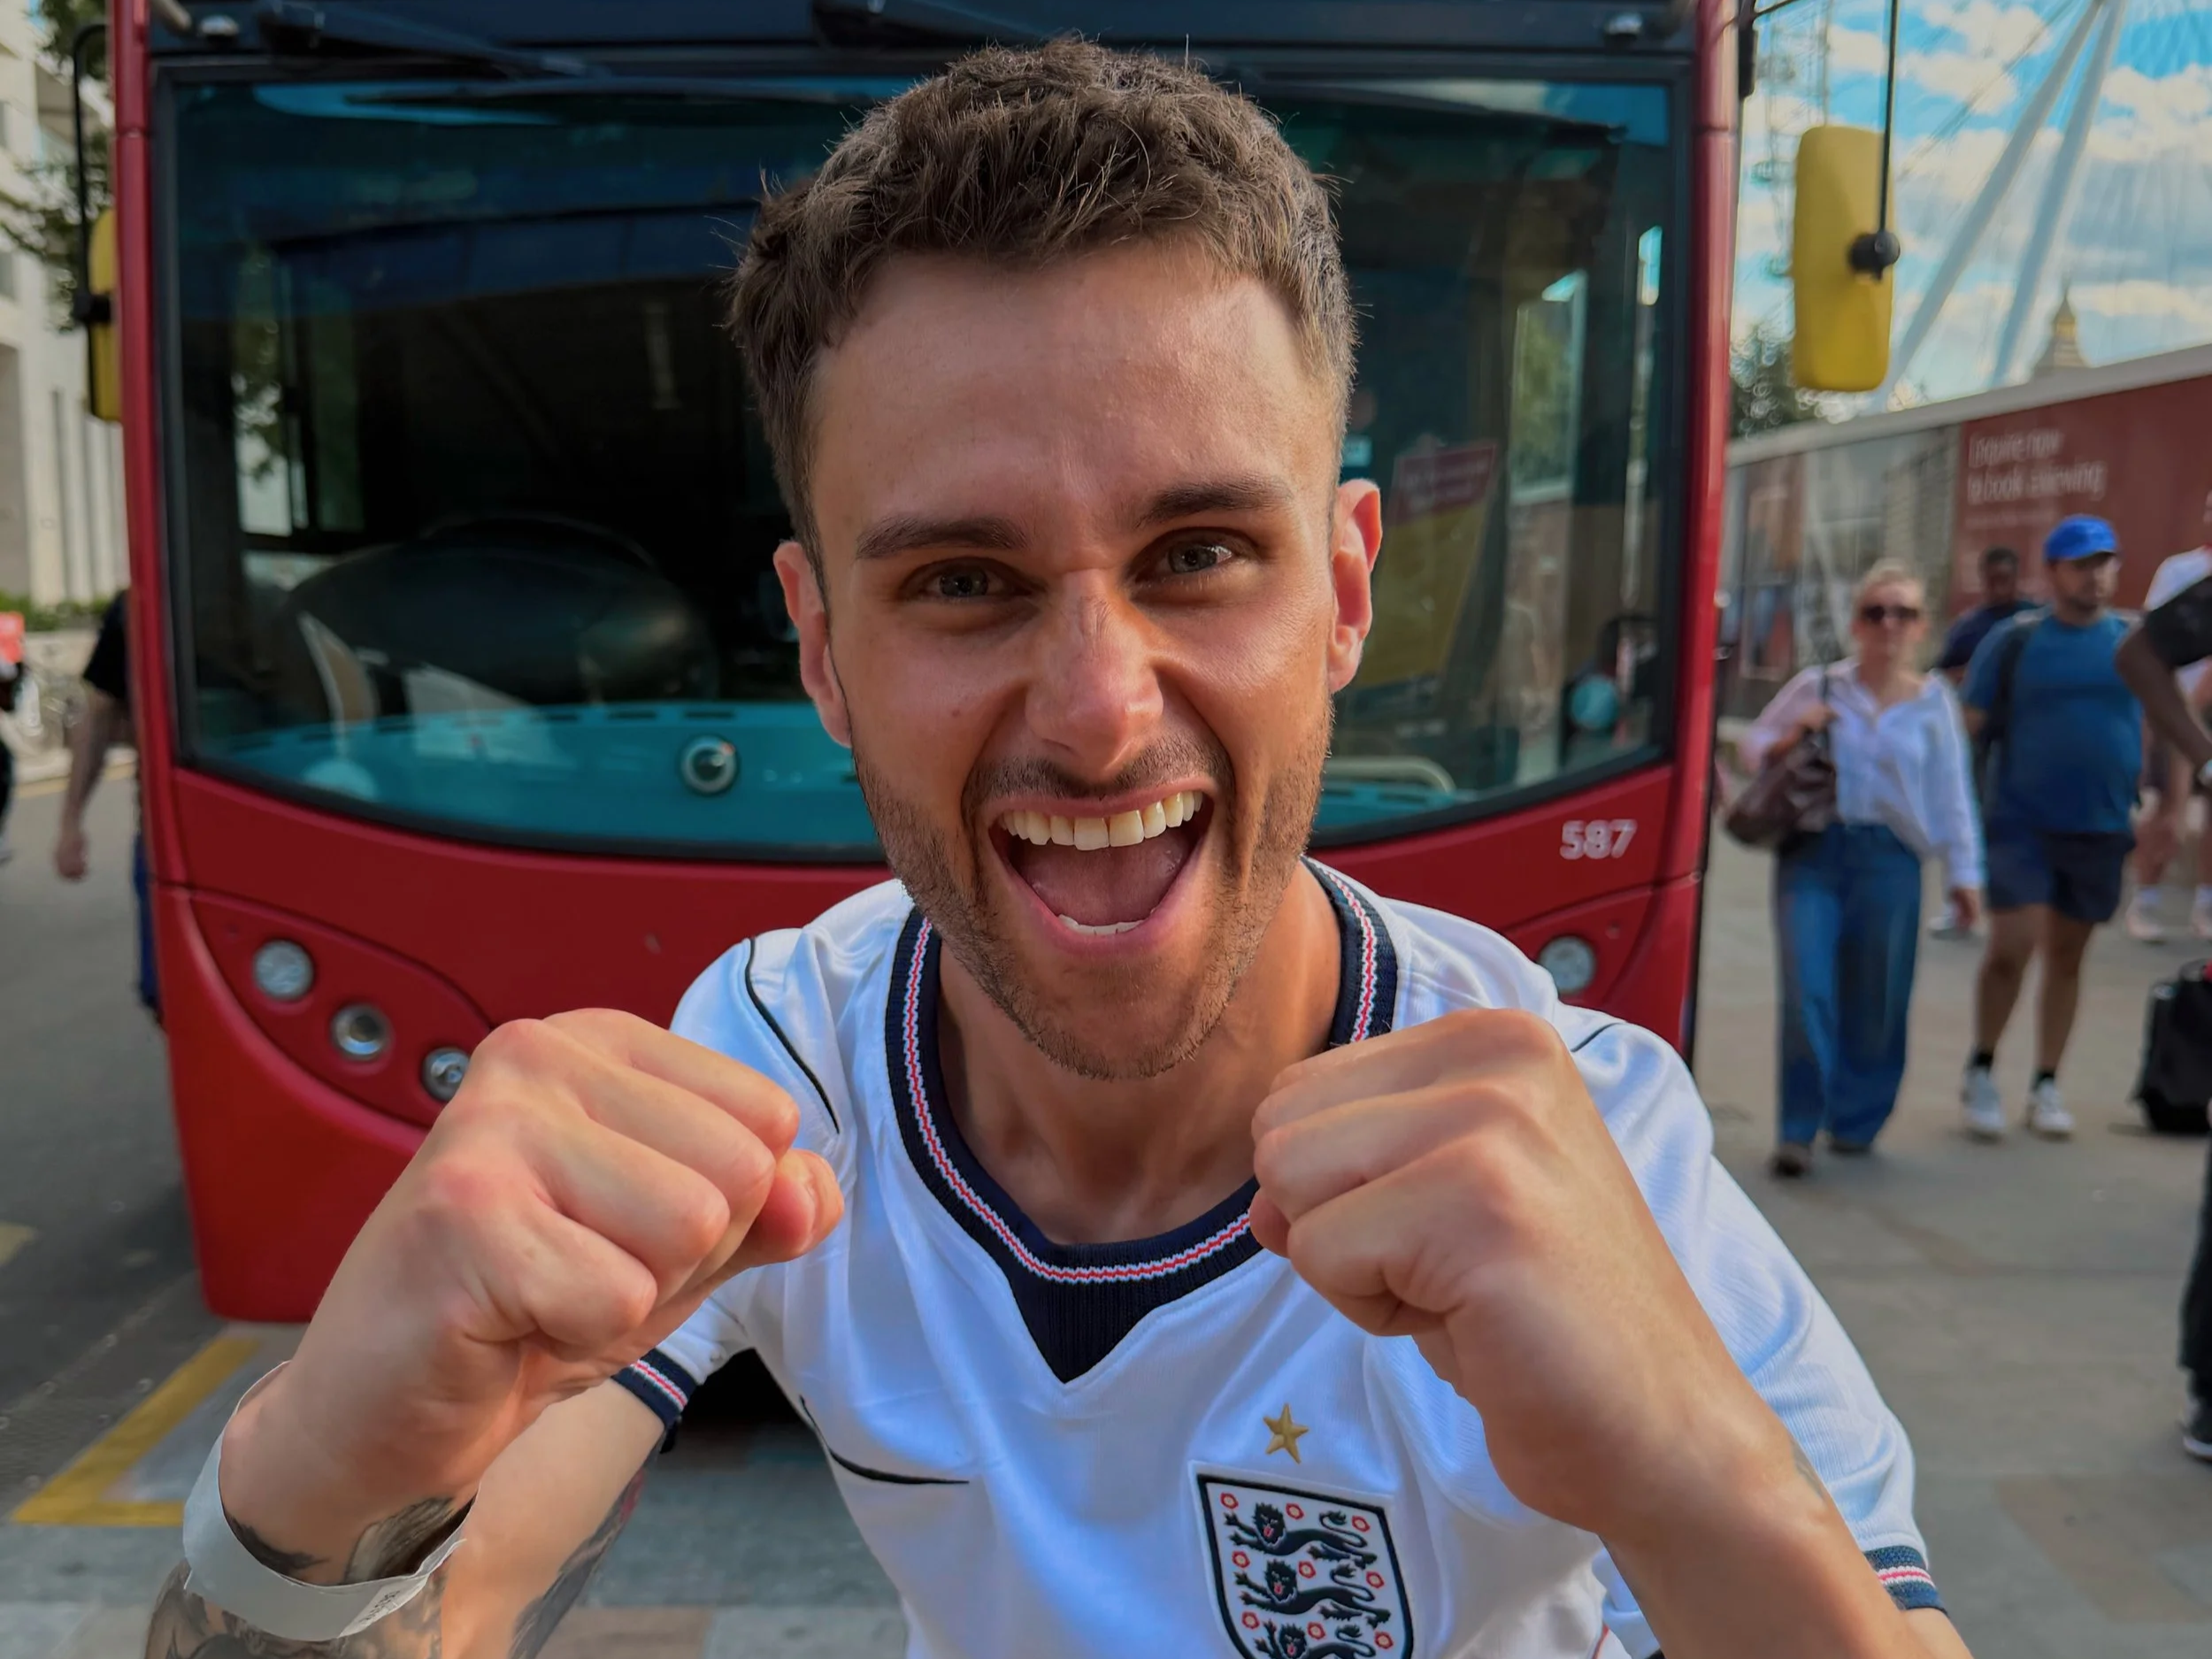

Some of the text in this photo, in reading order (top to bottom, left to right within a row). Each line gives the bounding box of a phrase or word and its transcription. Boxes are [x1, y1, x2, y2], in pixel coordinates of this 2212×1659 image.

[2027, 429, 2065, 458] now
[1984, 465, 2024, 502] book
[1560, 819, 1638, 860] 587
